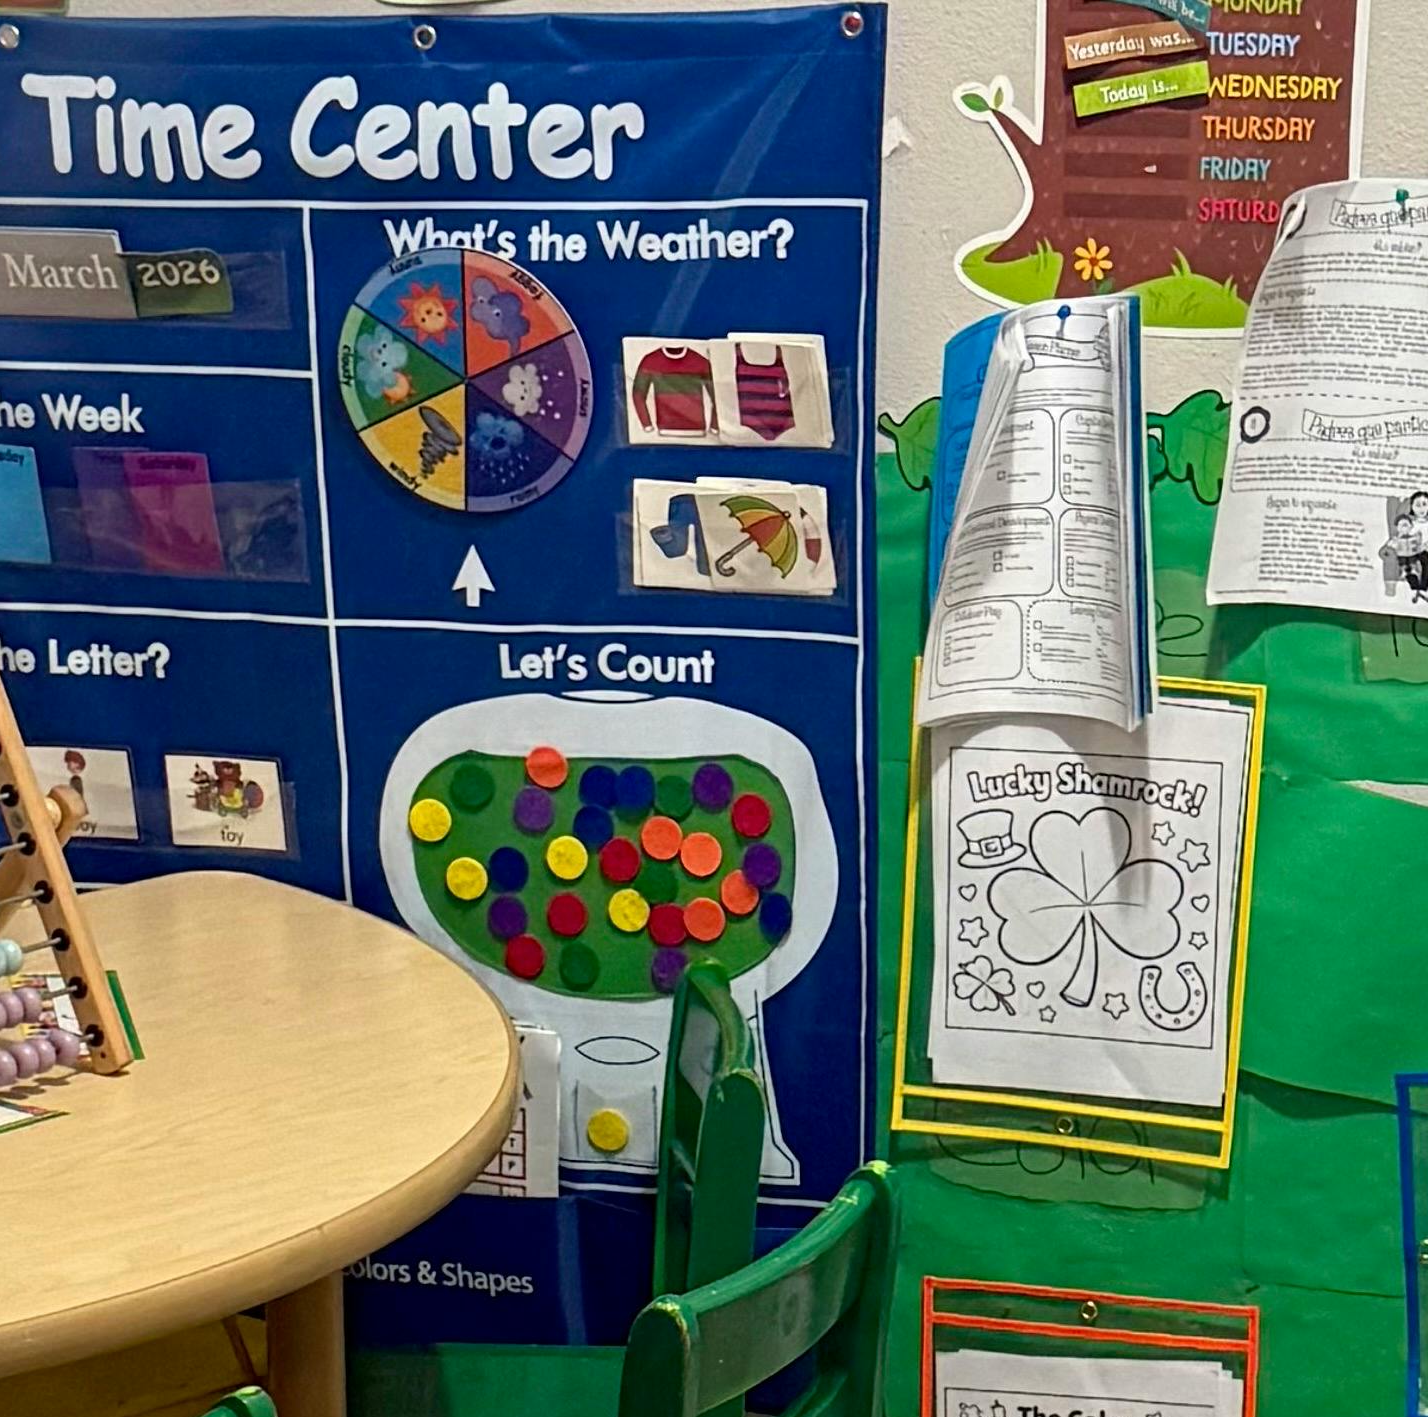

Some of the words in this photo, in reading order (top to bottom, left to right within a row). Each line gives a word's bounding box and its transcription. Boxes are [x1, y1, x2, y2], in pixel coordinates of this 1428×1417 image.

[1069, 36, 1146, 61] Yesterday
[1149, 31, 1196, 48] was...
[1205, 30, 1301, 58] TUESDAY
[1100, 83, 1148, 104] Today
[1207, 73, 1343, 101] WEDNESDAY
[20, 72, 262, 183] Time
[289, 74, 645, 181] Center
[1202, 114, 1316, 142] THURSDAY
[1199, 155, 1272, 182] FRIDAY
[1197, 196, 1281, 225] SATURD
[384, 218, 517, 261] What's
[529, 221, 587, 261] the
[598, 216, 795, 261] Weather?
[1, 253, 119, 290] March
[136, 258, 221, 288] 2026
[42, 391, 145, 434] Week
[48, 638, 171, 679] Letter?
[498, 643, 588, 683] Let's
[596, 643, 715, 685] Count
[966, 763, 1052, 804] Lucky
[1056, 762, 1209, 818] Shamrock!
[220, 825, 244, 846] toy
[416, 1260, 438, 1286] &
[441, 1262, 534, 1297] Shapes
